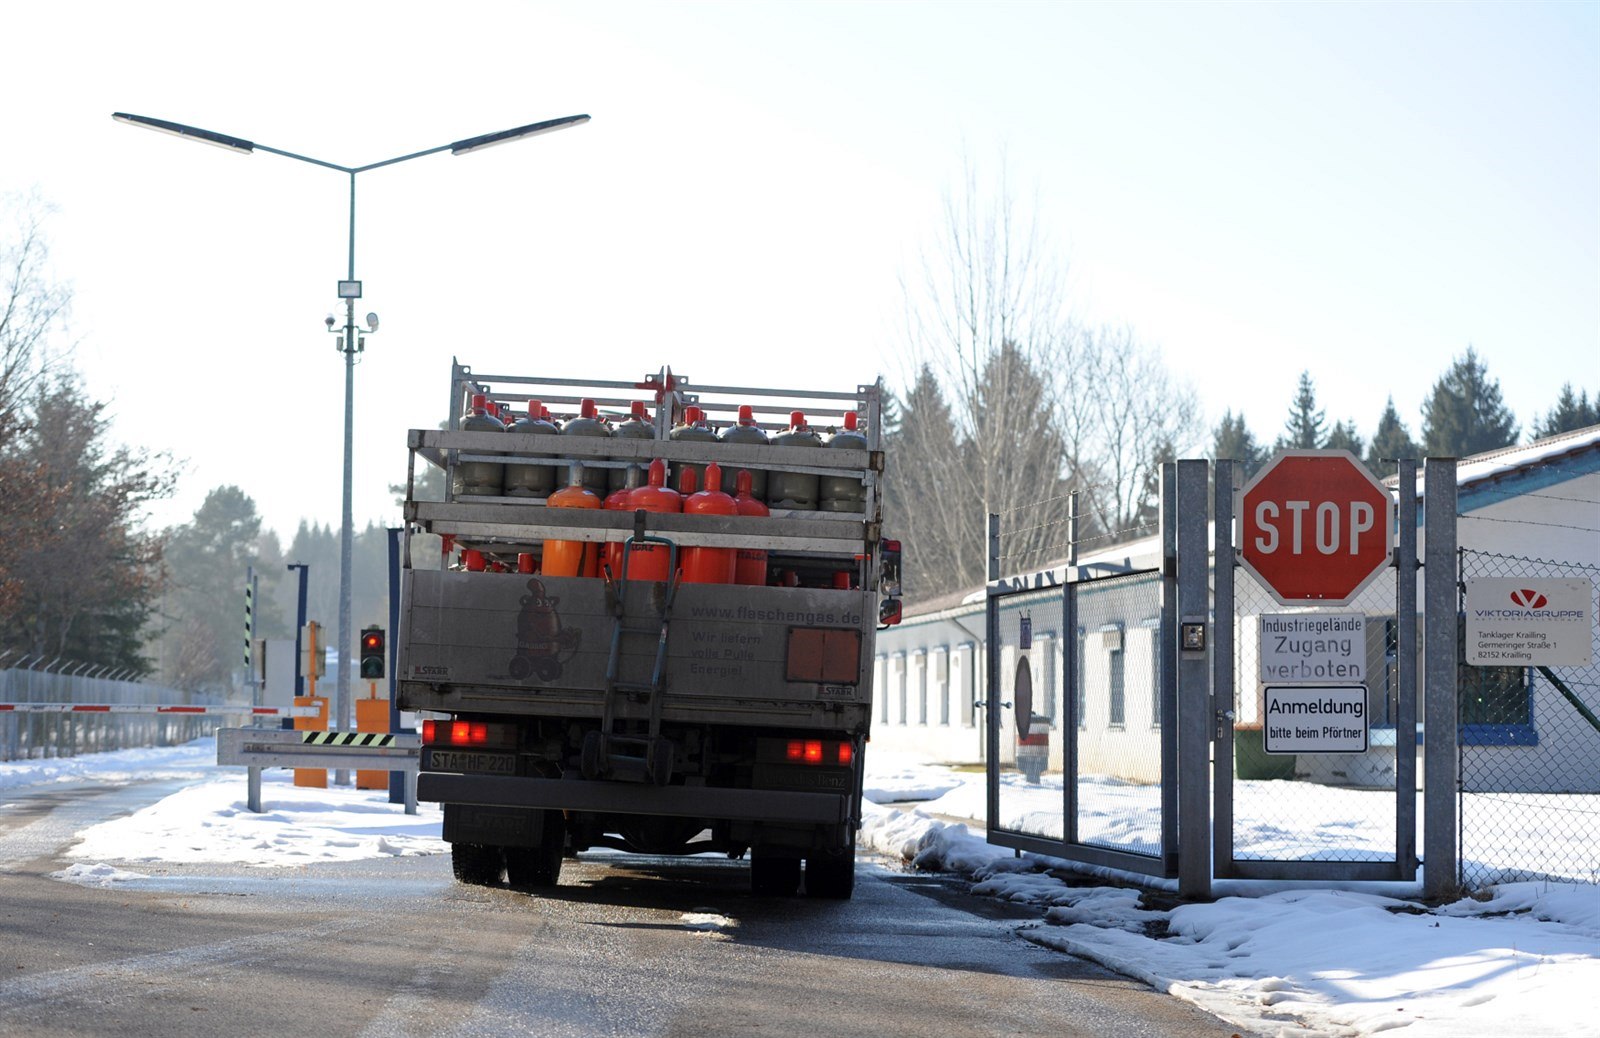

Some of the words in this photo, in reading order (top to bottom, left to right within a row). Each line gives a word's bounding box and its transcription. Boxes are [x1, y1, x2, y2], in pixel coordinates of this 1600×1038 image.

[1255, 500, 1374, 555] STOP
[691, 606, 860, 624] www.flaschengas.de
[1475, 609, 1584, 618] VIKTORIAGRUPPE
[1262, 617, 1362, 636] Industriegelände
[692, 631, 716, 643] Wir
[720, 632, 760, 645] liefern
[1478, 631, 1514, 640] Tanklager
[1516, 631, 1547, 640] Krailling
[1274, 636, 1351, 657] Zugang
[1478, 641, 1525, 650] Germeringer
[1527, 641, 1551, 649] Straße
[1553, 641, 1557, 649] 1
[691, 648, 719, 658] volle
[724, 649, 754, 660] Pulle
[1478, 651, 1499, 659] 82152
[1501, 651, 1532, 660] Krailling
[1267, 660, 1360, 679] verboten
[1269, 699, 1364, 718] Anmeldung
[1270, 727, 1292, 739] bitte
[1295, 727, 1319, 739] beim
[1322, 726, 1363, 740] Pförtner
[432, 752, 458, 768] STA
[467, 755, 486, 770] HF
[488, 756, 514, 772] 220
